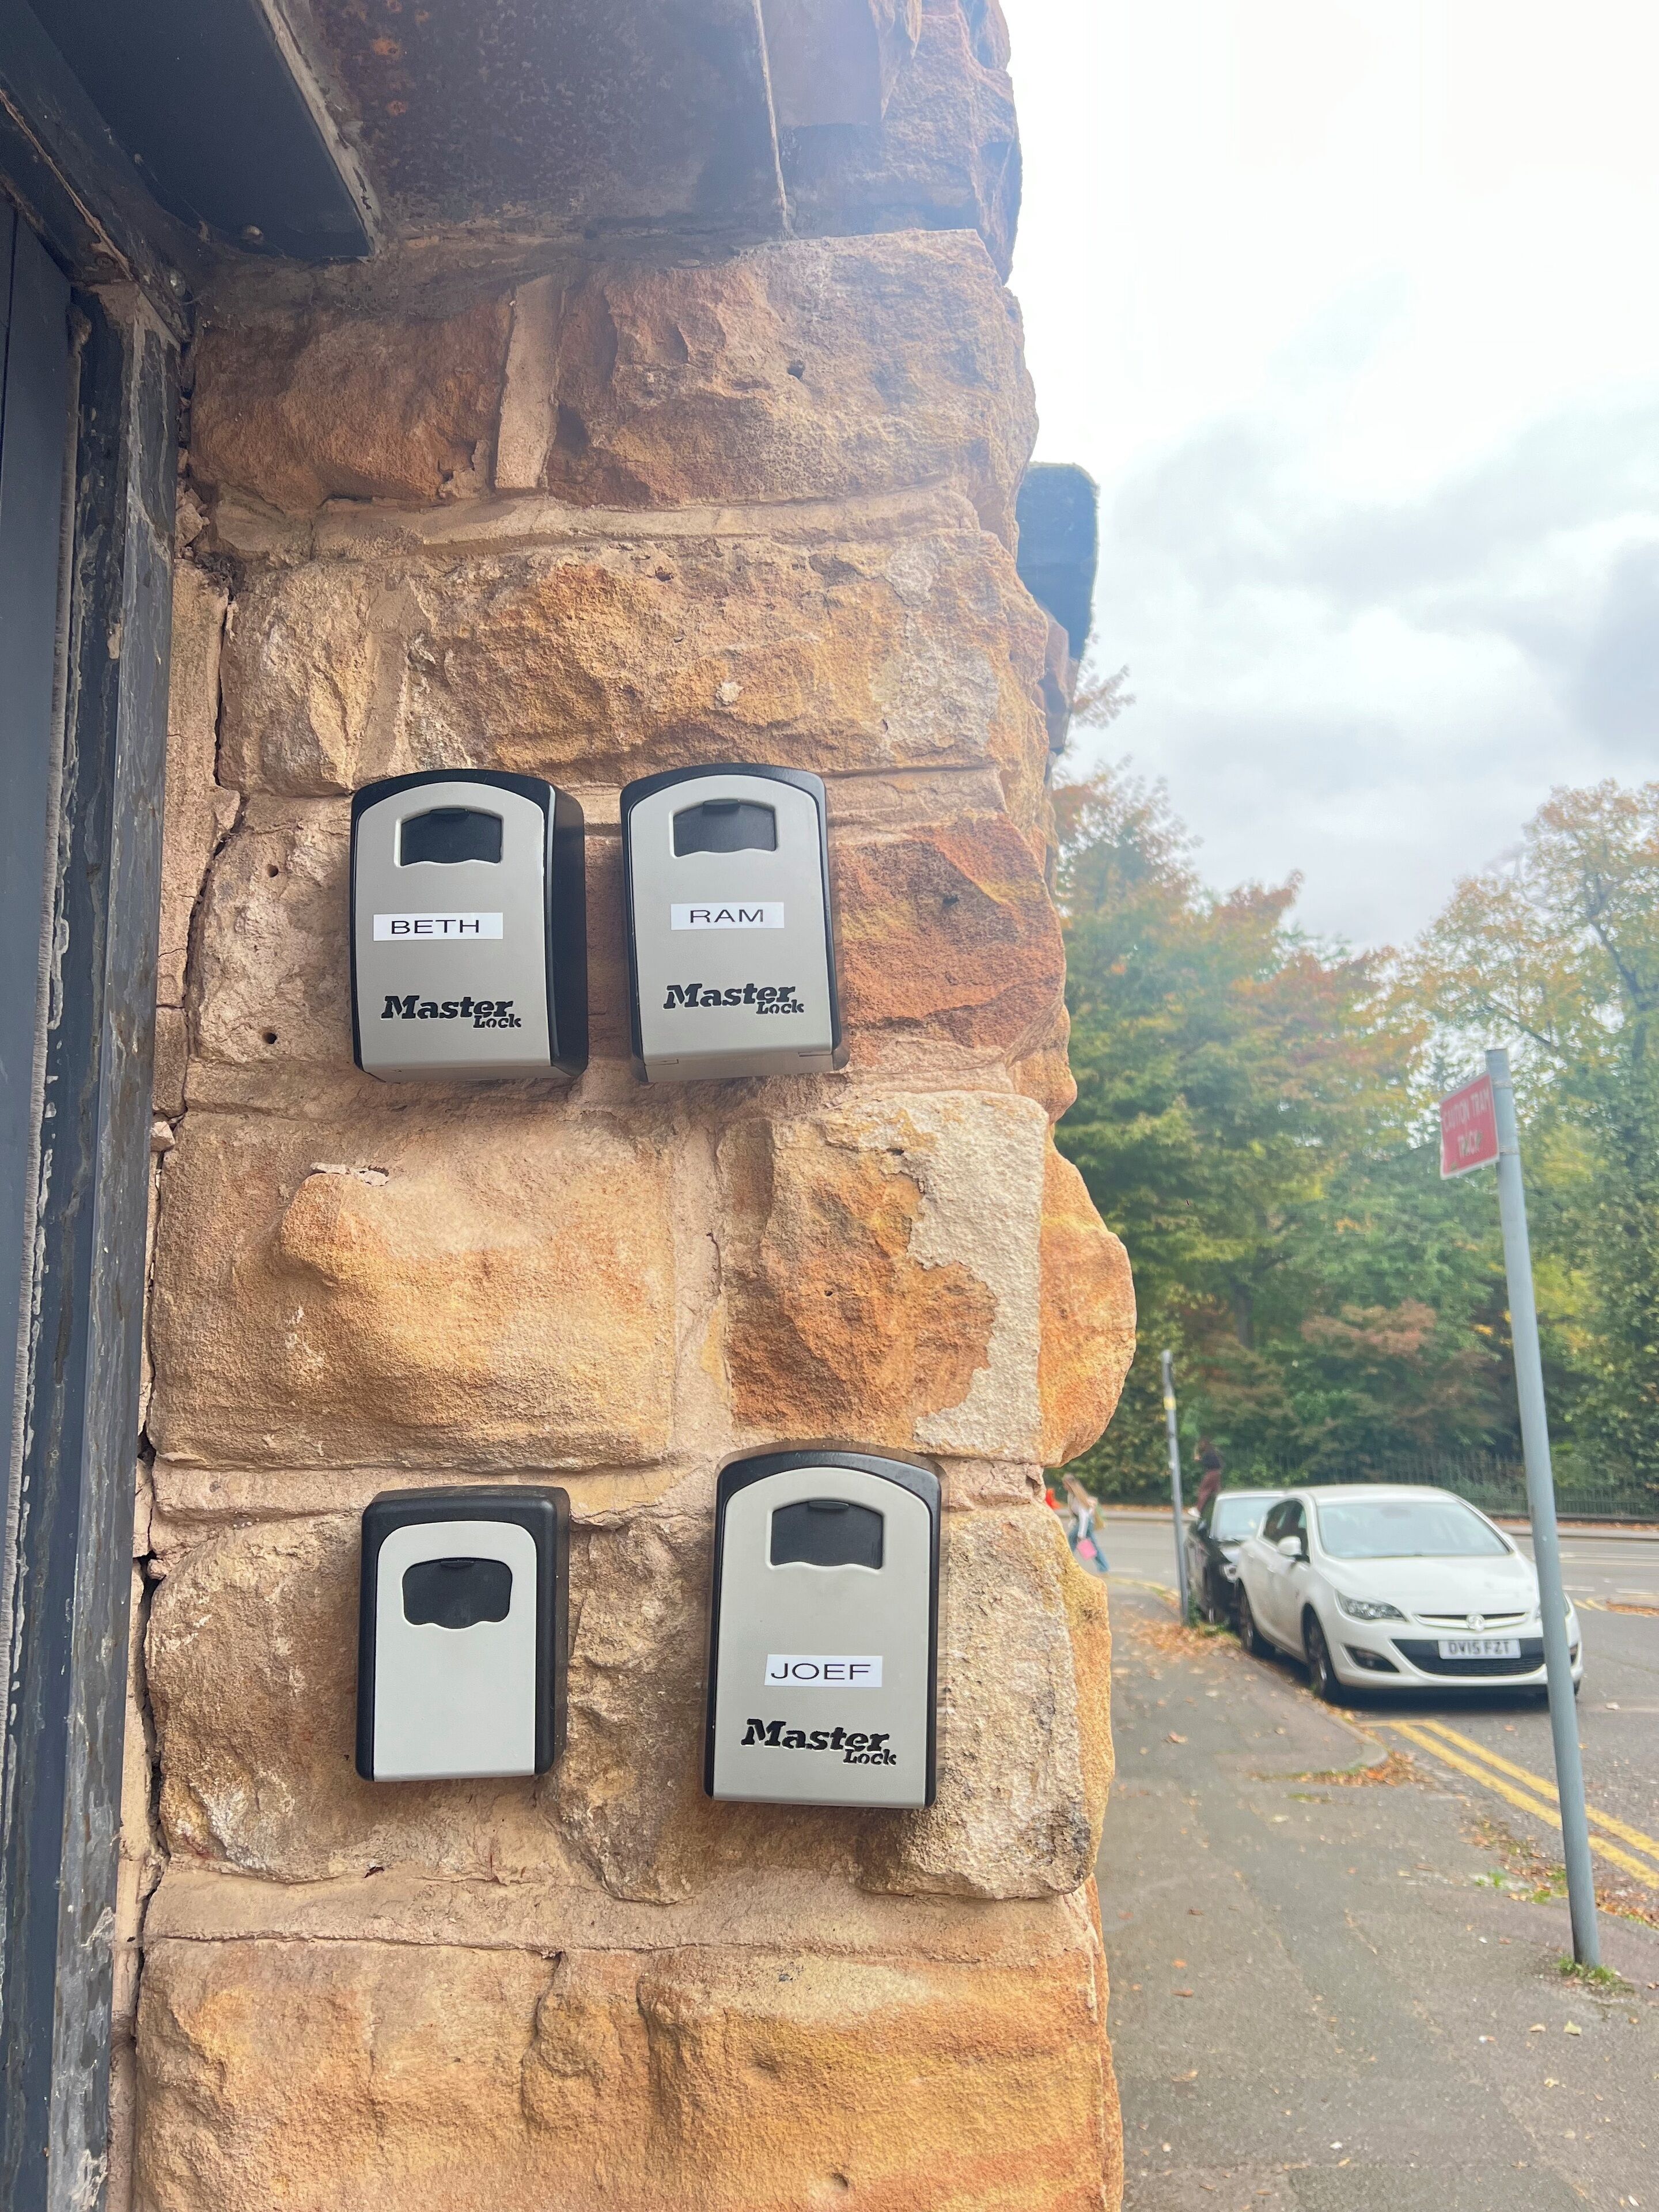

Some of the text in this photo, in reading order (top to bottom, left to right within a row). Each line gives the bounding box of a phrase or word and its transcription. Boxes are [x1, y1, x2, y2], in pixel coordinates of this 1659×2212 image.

[690, 909, 764, 923] RAM
[391, 920, 480, 934] BETH
[663, 983, 796, 1009] Master
[381, 995, 514, 1020] Master
[756, 999, 805, 1014] Lock
[473, 1014, 522, 1028] Lock
[771, 1662, 871, 1680] JOEF
[740, 1718, 891, 1752] Master
[842, 1748, 897, 1766] Lock
